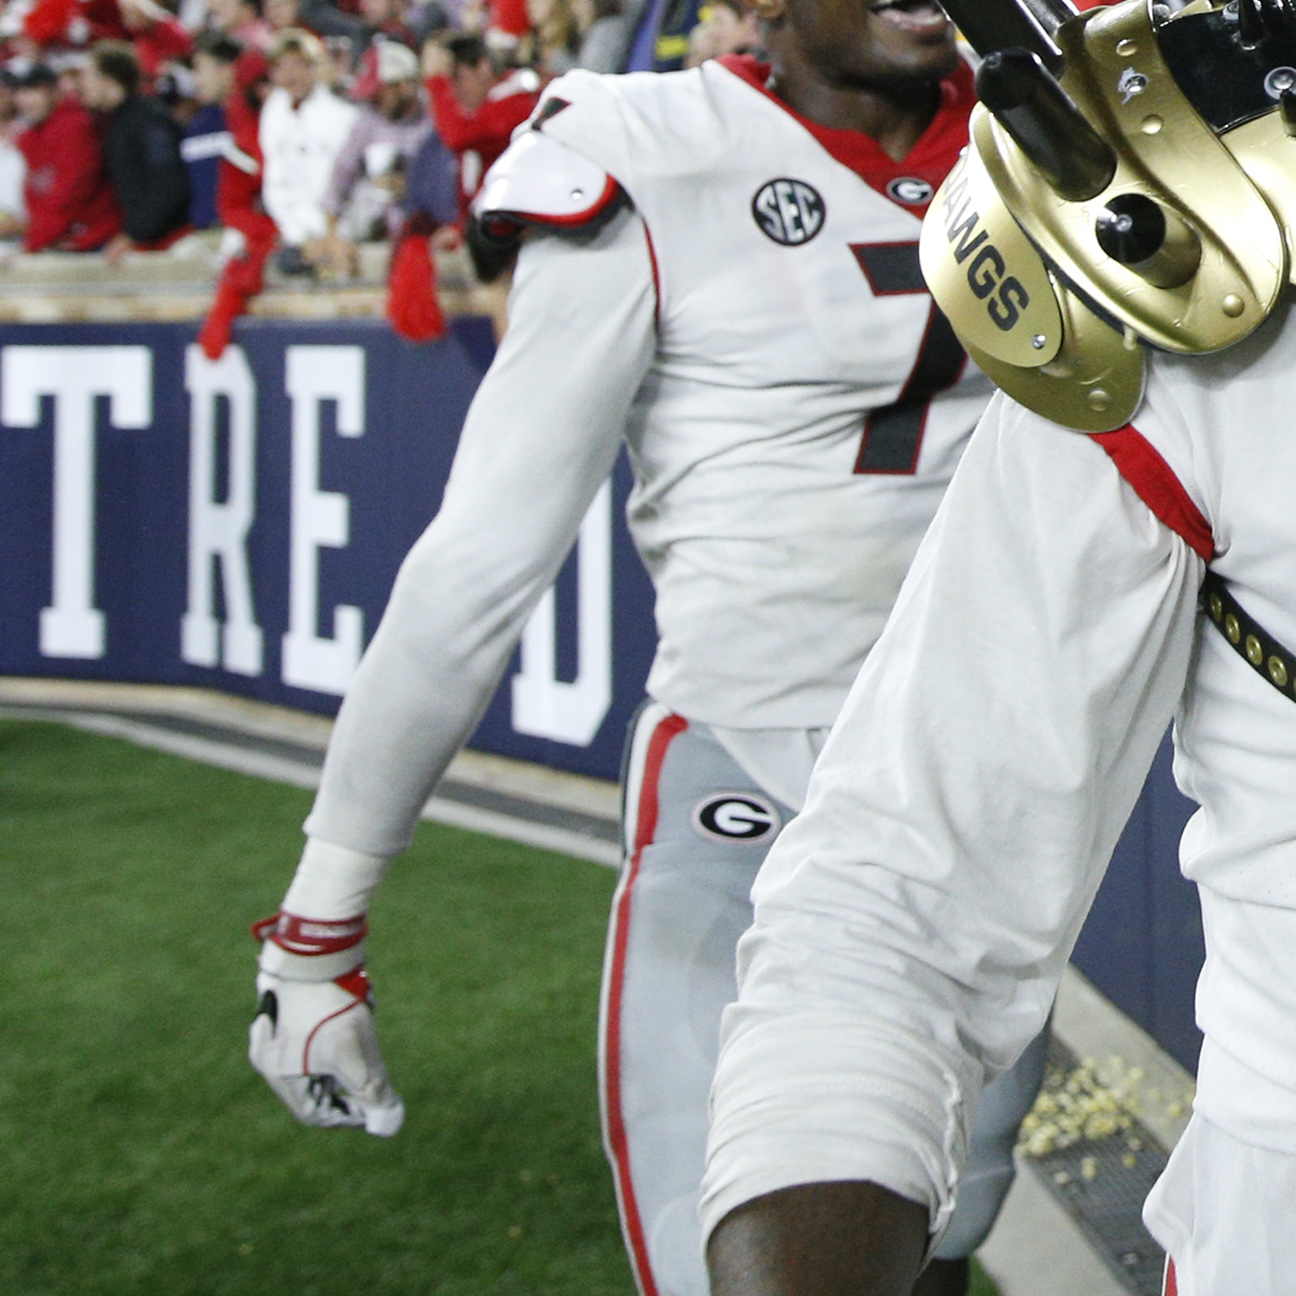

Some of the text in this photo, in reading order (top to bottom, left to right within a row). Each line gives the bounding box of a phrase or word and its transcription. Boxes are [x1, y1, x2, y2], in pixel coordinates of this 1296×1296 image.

[755, 180, 823, 245] SEC
[889, 178, 934, 203] G
[848, 240, 970, 475] 7
[699, 797, 773, 839] G
